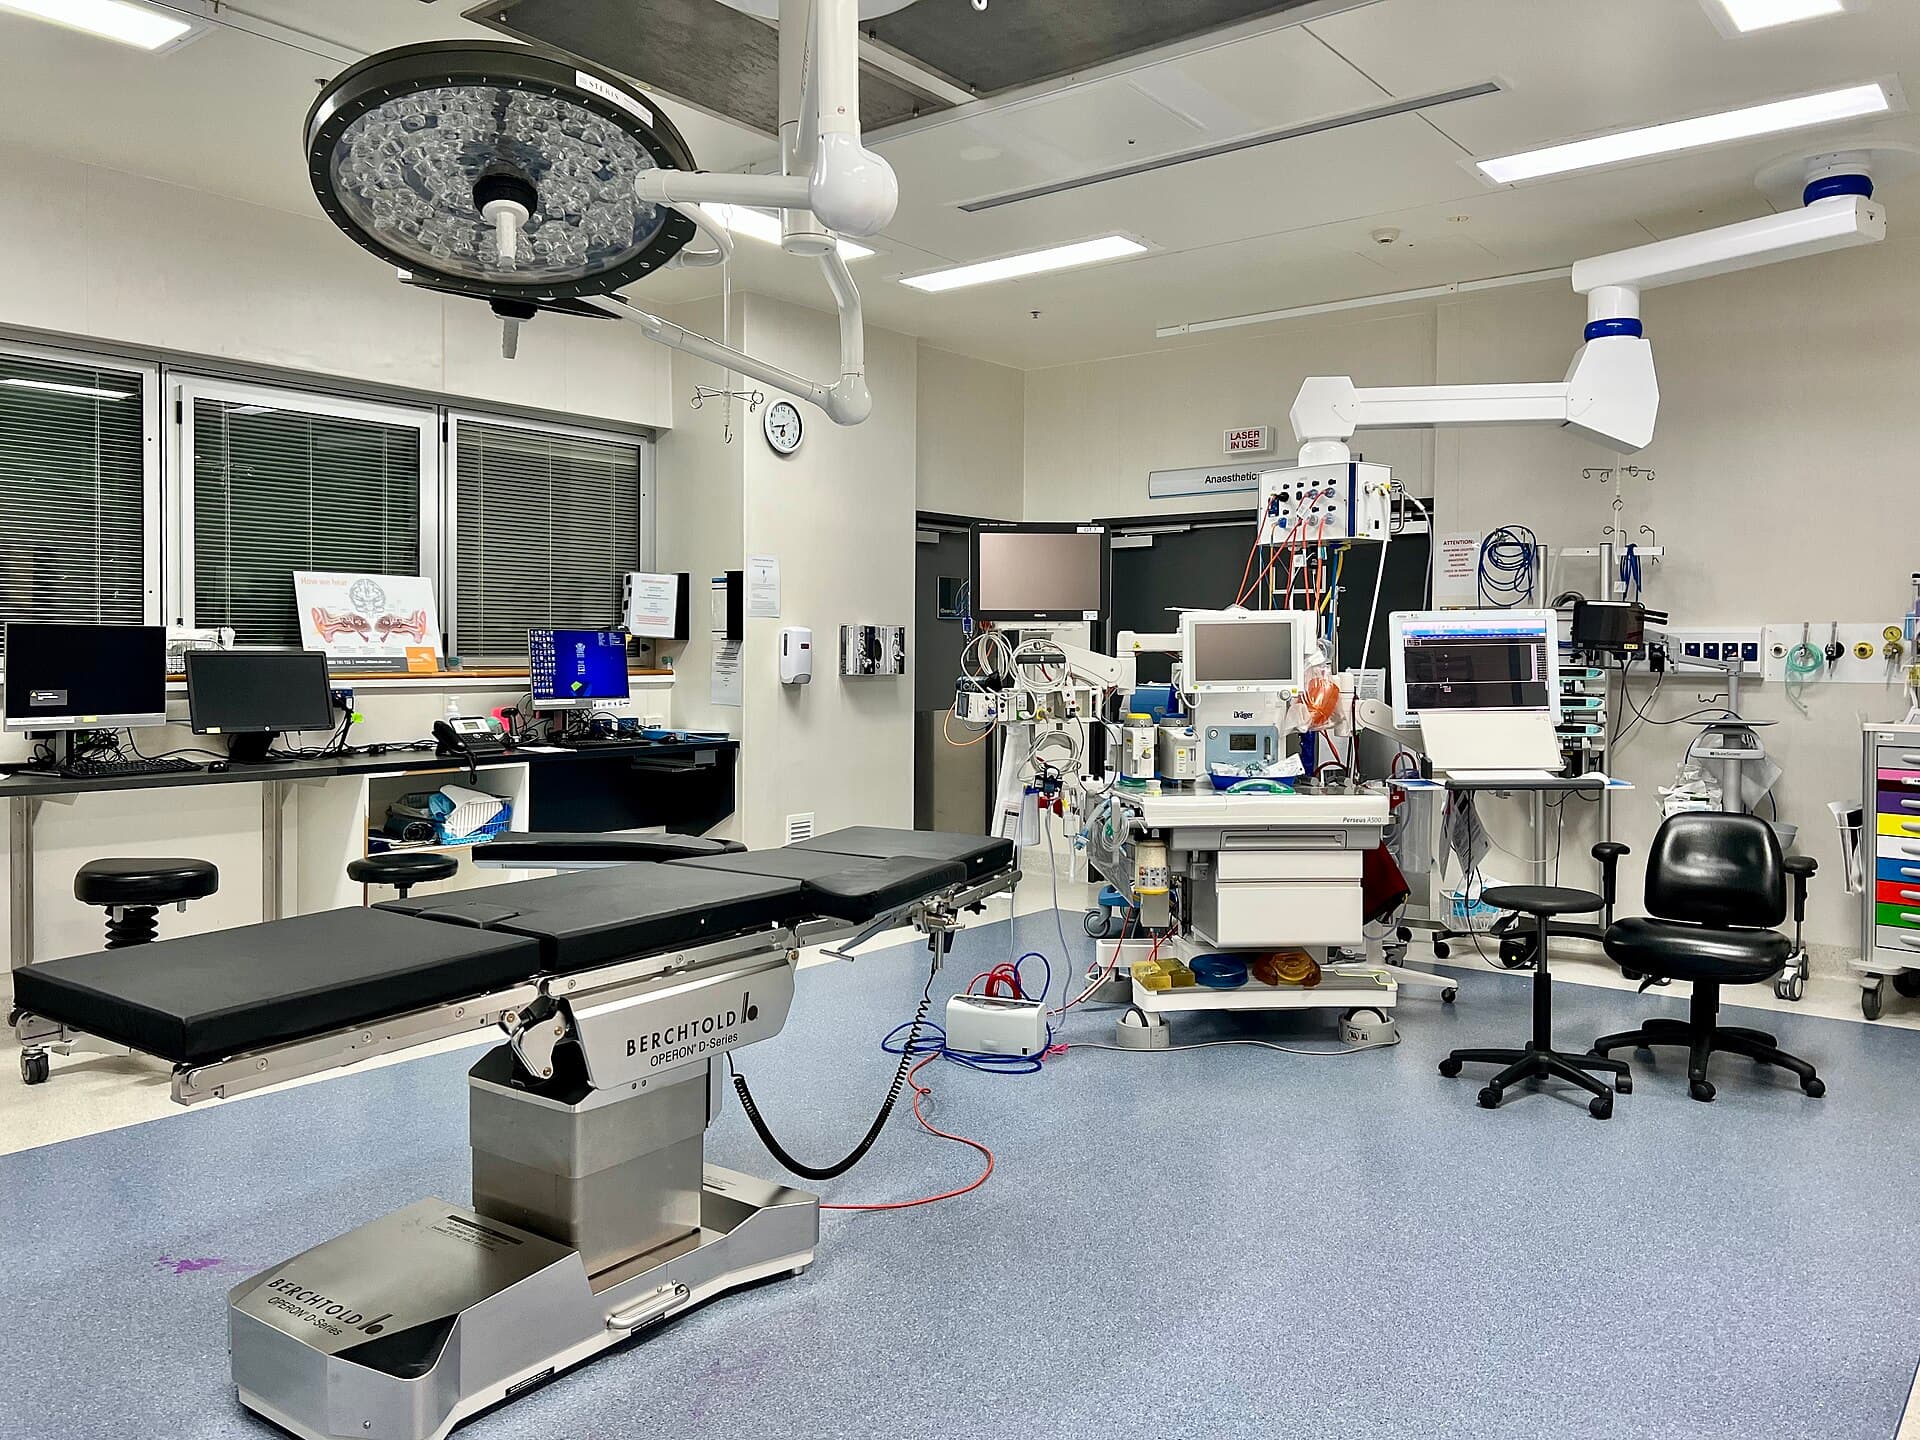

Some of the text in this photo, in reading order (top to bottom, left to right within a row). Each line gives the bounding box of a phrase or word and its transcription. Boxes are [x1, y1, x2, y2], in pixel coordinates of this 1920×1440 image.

[1230, 430, 1260, 441] LASER
[1230, 439, 1260, 450] IN USE
[1233, 710, 1254, 720] Dräger
[626, 1010, 736, 1057] BERCHTOLD
[698, 1032, 738, 1053] D-Series
[267, 1278, 363, 1325] BERCHTOLD
[304, 1313, 343, 1336] D-Series
